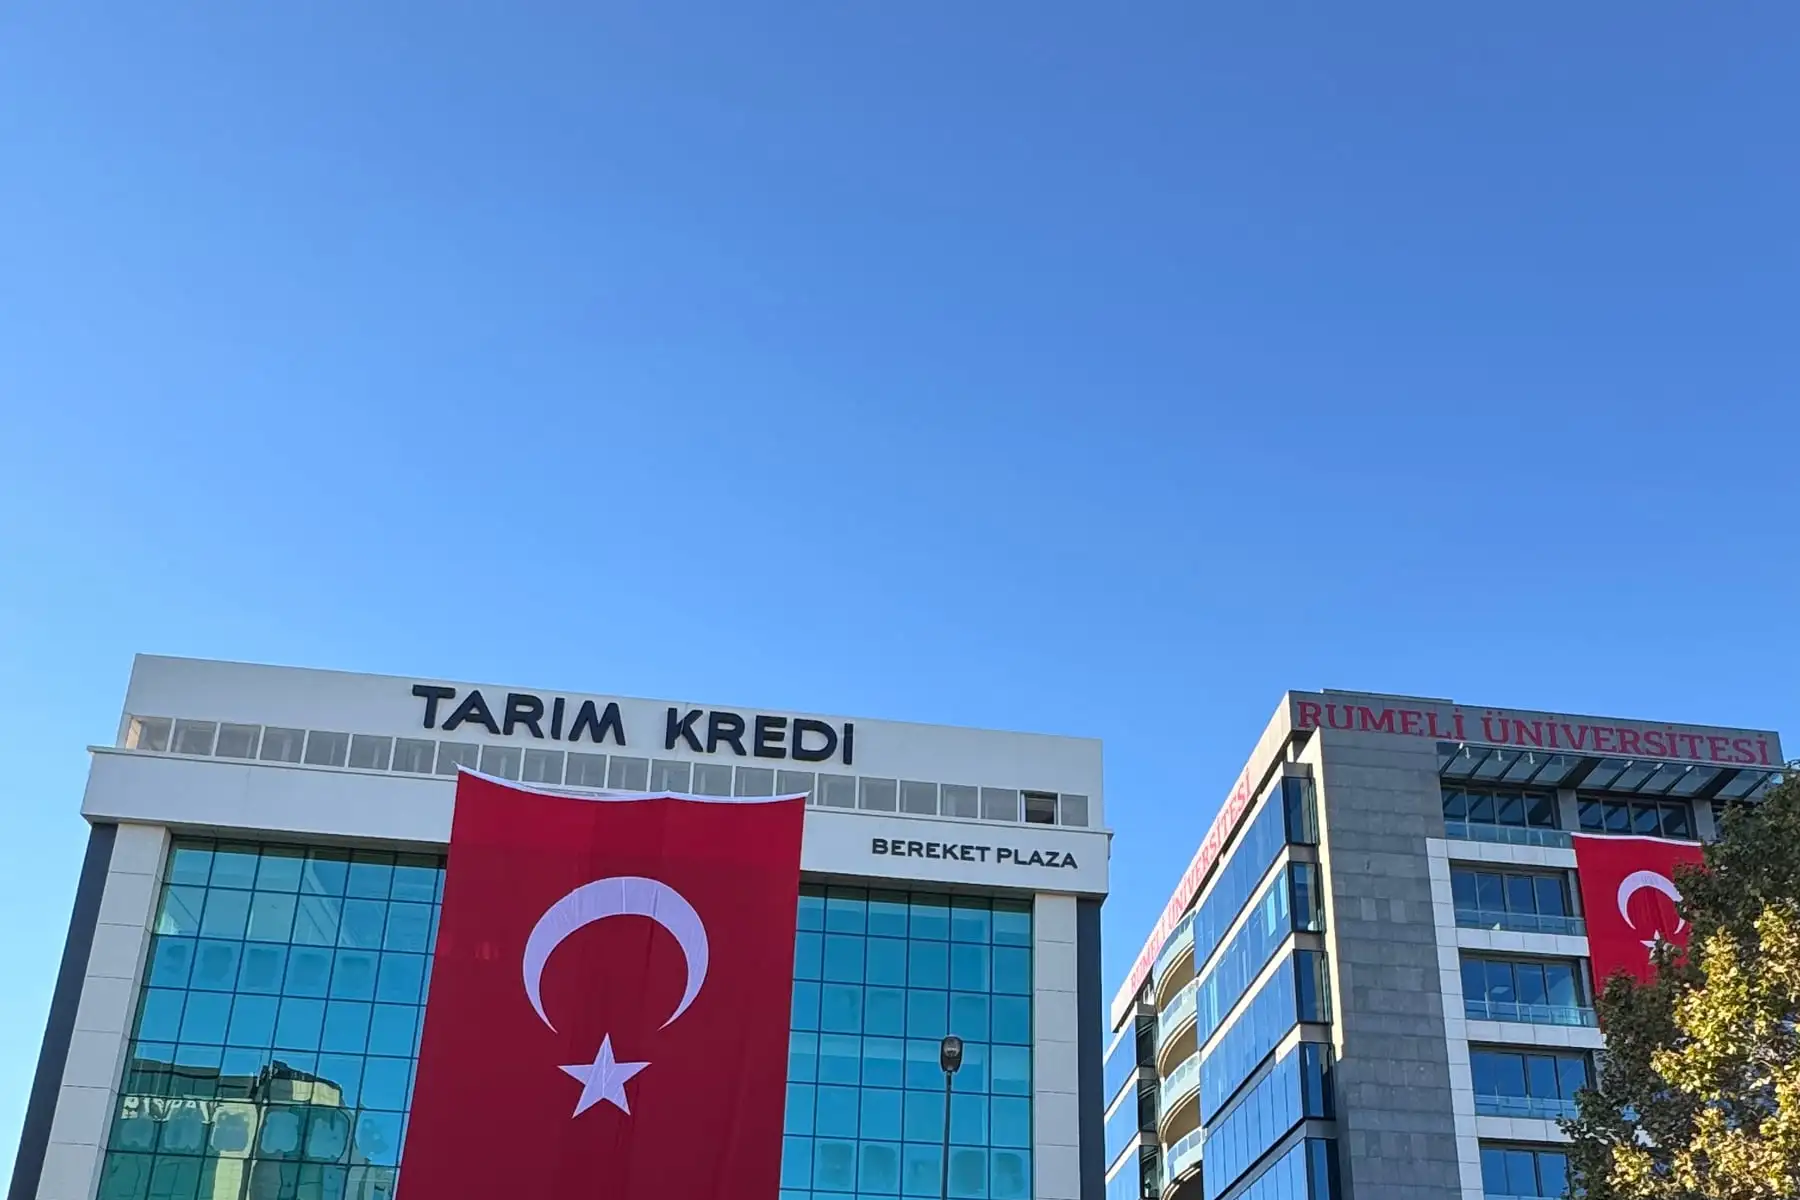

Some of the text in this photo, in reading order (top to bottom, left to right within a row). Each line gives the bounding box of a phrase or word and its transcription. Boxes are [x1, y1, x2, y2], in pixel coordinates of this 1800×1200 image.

[412, 684, 626, 746] TARIM
[1296, 701, 1772, 765] RUMELİ ÜNİVERSİTESİ
[872, 838, 1078, 869] BEREKET PLAZA
